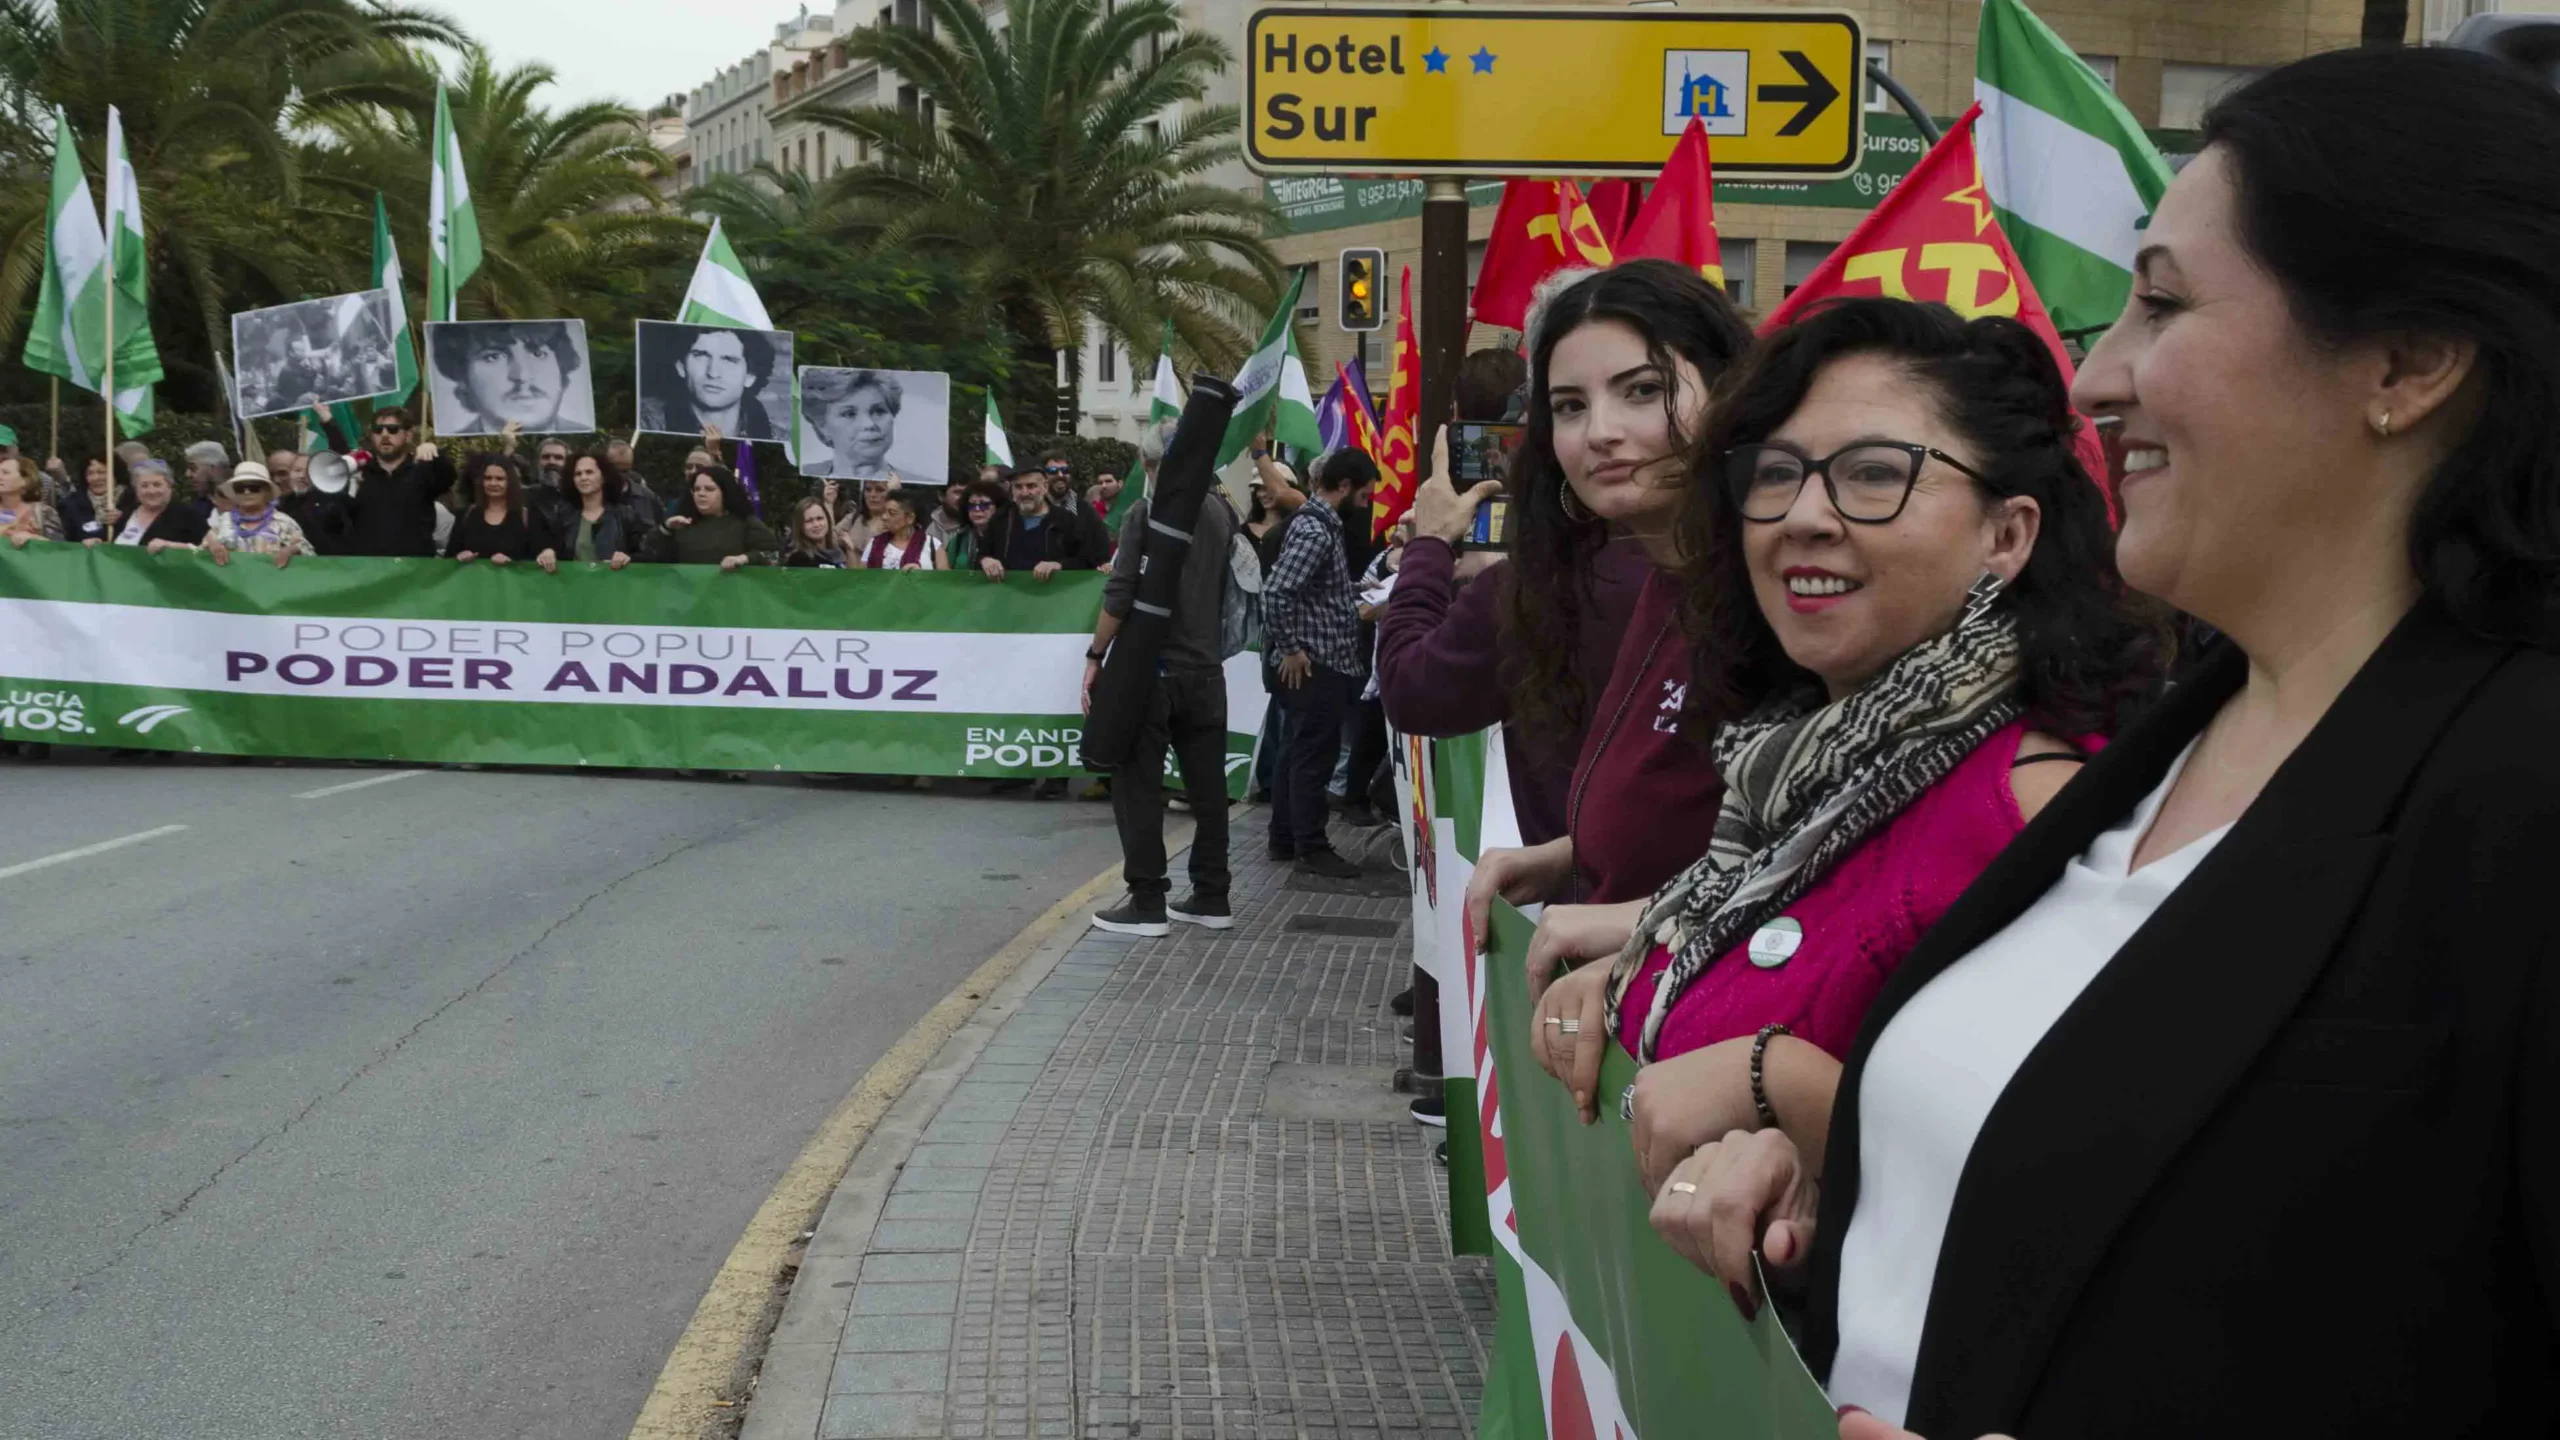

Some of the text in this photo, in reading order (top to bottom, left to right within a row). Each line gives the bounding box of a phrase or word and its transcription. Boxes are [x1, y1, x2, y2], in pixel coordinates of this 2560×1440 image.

[1265, 33, 1405, 75] Hotel
[1265, 93, 1377, 142] Sur
[1282, 177, 1330, 203] INTEGRAL
[294, 623, 871, 664] PODER POPULAR
[226, 651, 938, 701] PODER ANDALUZ
[0, 689, 85, 710] UCÍA
[966, 727, 1084, 743] EN AND
[965, 743, 1084, 767] PODE
